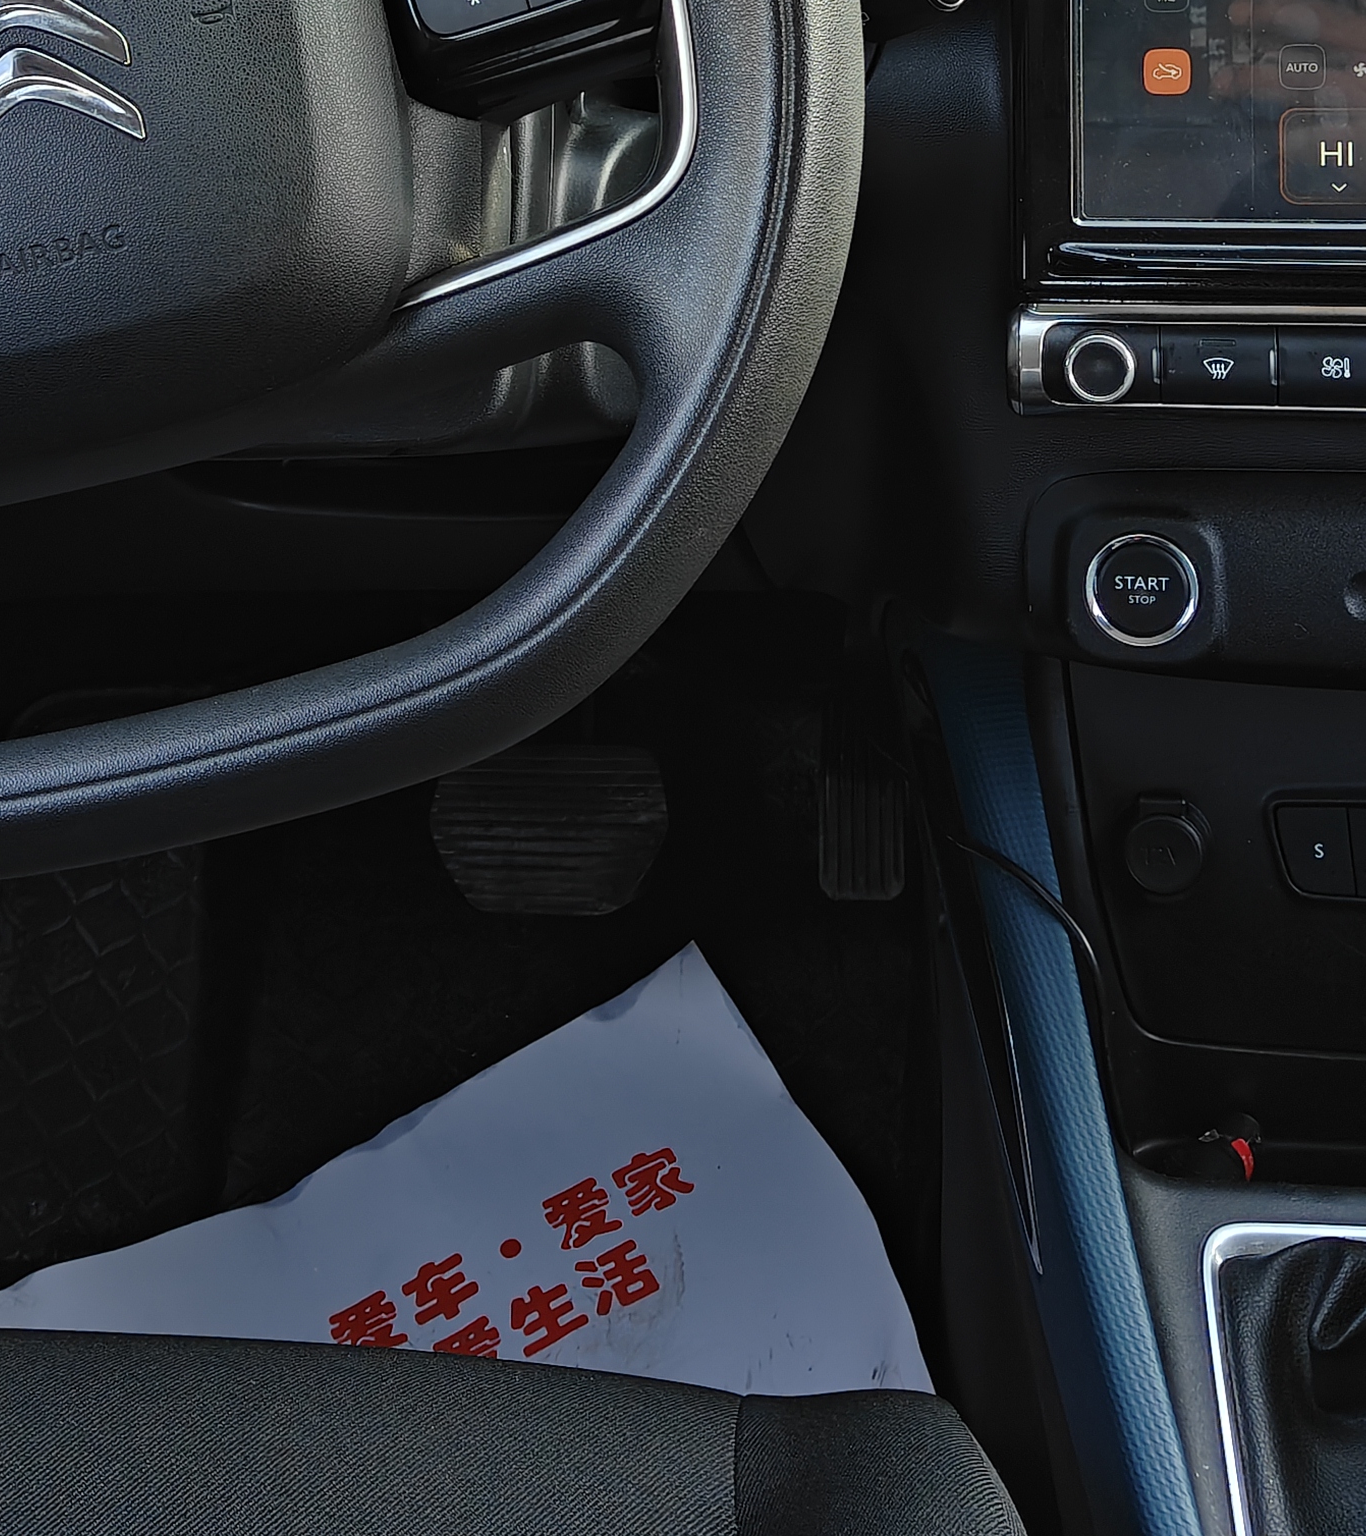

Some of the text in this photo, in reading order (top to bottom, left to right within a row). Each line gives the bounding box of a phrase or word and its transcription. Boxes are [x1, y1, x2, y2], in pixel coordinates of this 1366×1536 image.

[1285, 62, 1319, 73] AUTO
[1319, 141, 1355, 167] HI
[1114, 575, 1170, 592] START
[1128, 594, 1156, 605] STOP
[1313, 842, 1325, 859] S
